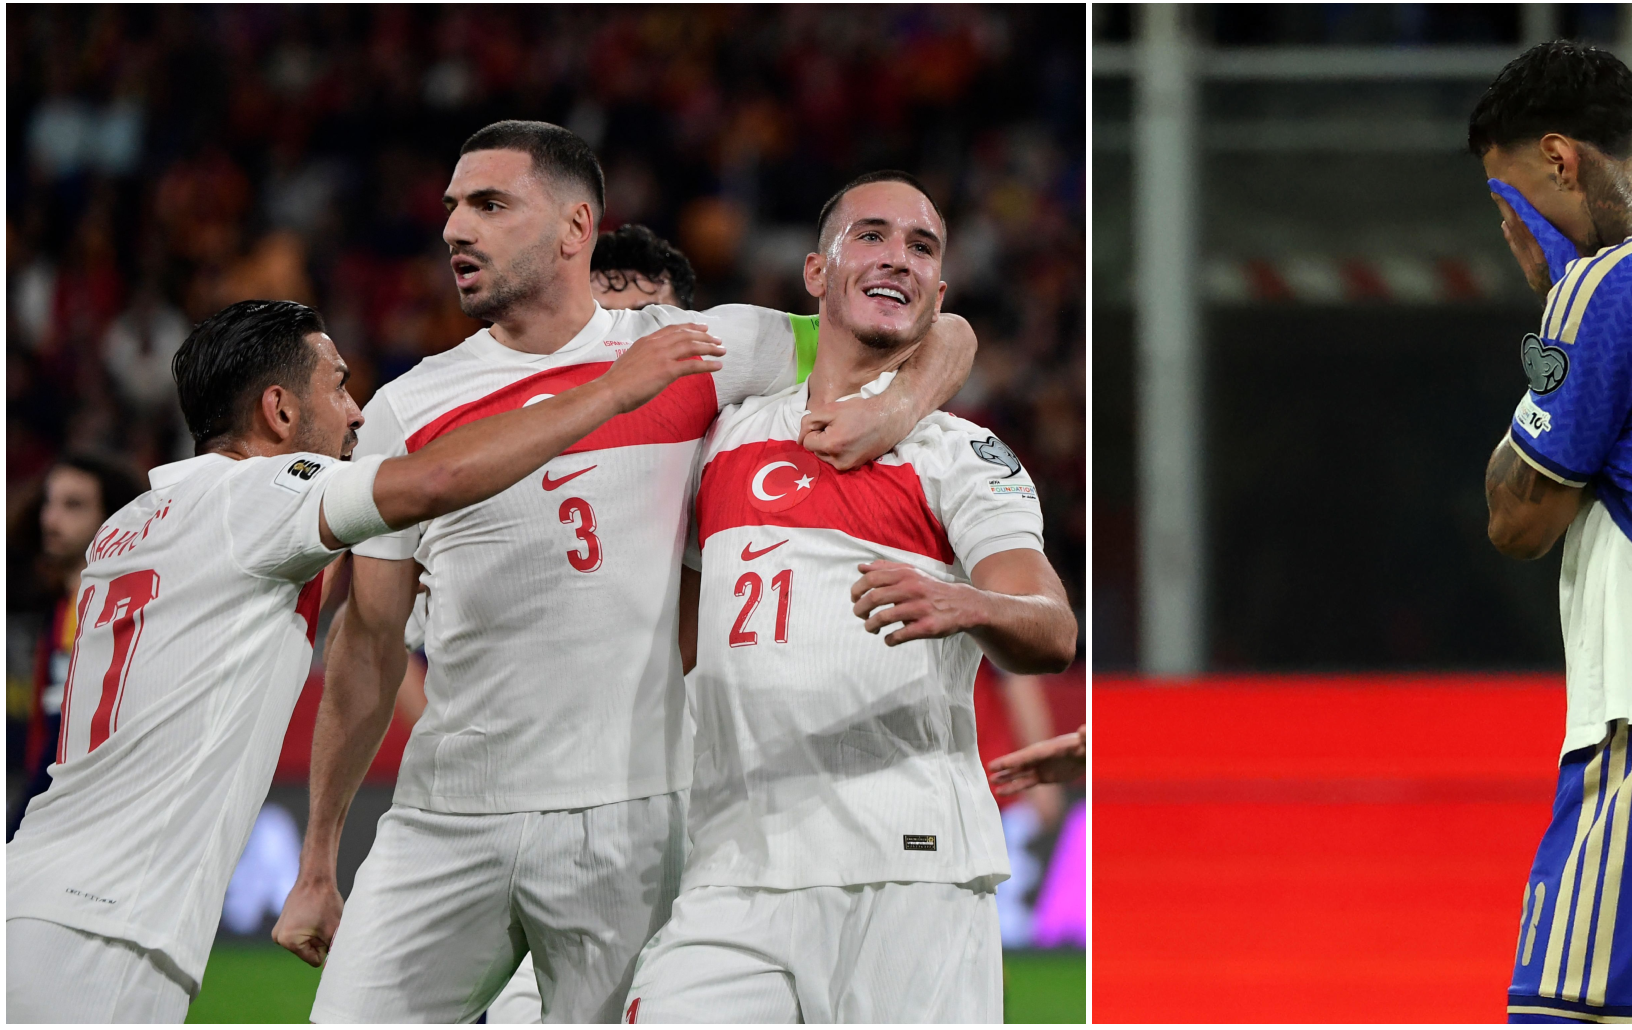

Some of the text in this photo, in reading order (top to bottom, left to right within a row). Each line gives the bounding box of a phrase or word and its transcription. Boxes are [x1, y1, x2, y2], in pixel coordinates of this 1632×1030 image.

[558, 497, 603, 573] 3
[729, 568, 793, 648] 21
[55, 569, 160, 765] 17
